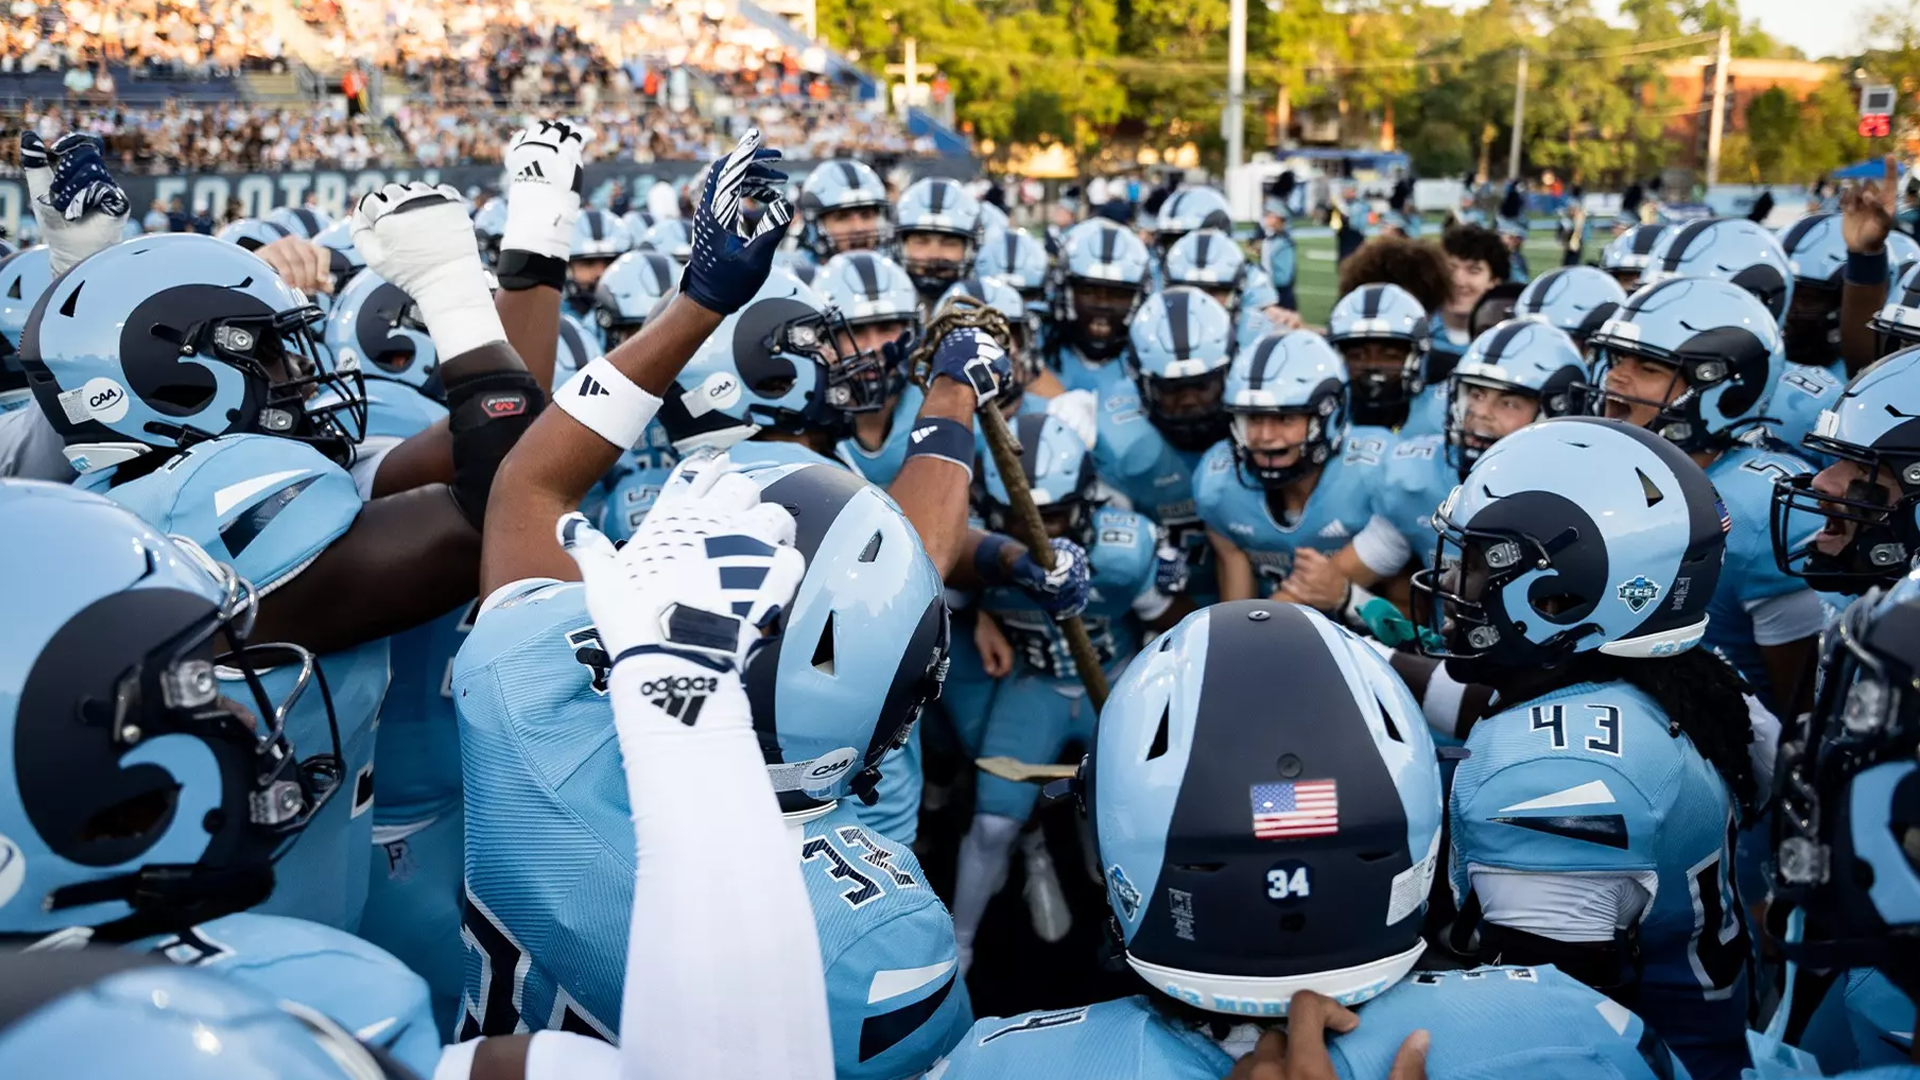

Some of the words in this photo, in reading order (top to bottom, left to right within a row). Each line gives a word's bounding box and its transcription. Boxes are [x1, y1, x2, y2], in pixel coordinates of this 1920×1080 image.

[155, 169, 441, 222] FOOTB
[90, 389, 117, 407] CAA
[710, 381, 731, 397] CAA
[1624, 588, 1653, 597] FCS
[1529, 703, 1623, 759] 43
[811, 758, 849, 776] CAA
[1267, 866, 1310, 899] 34
